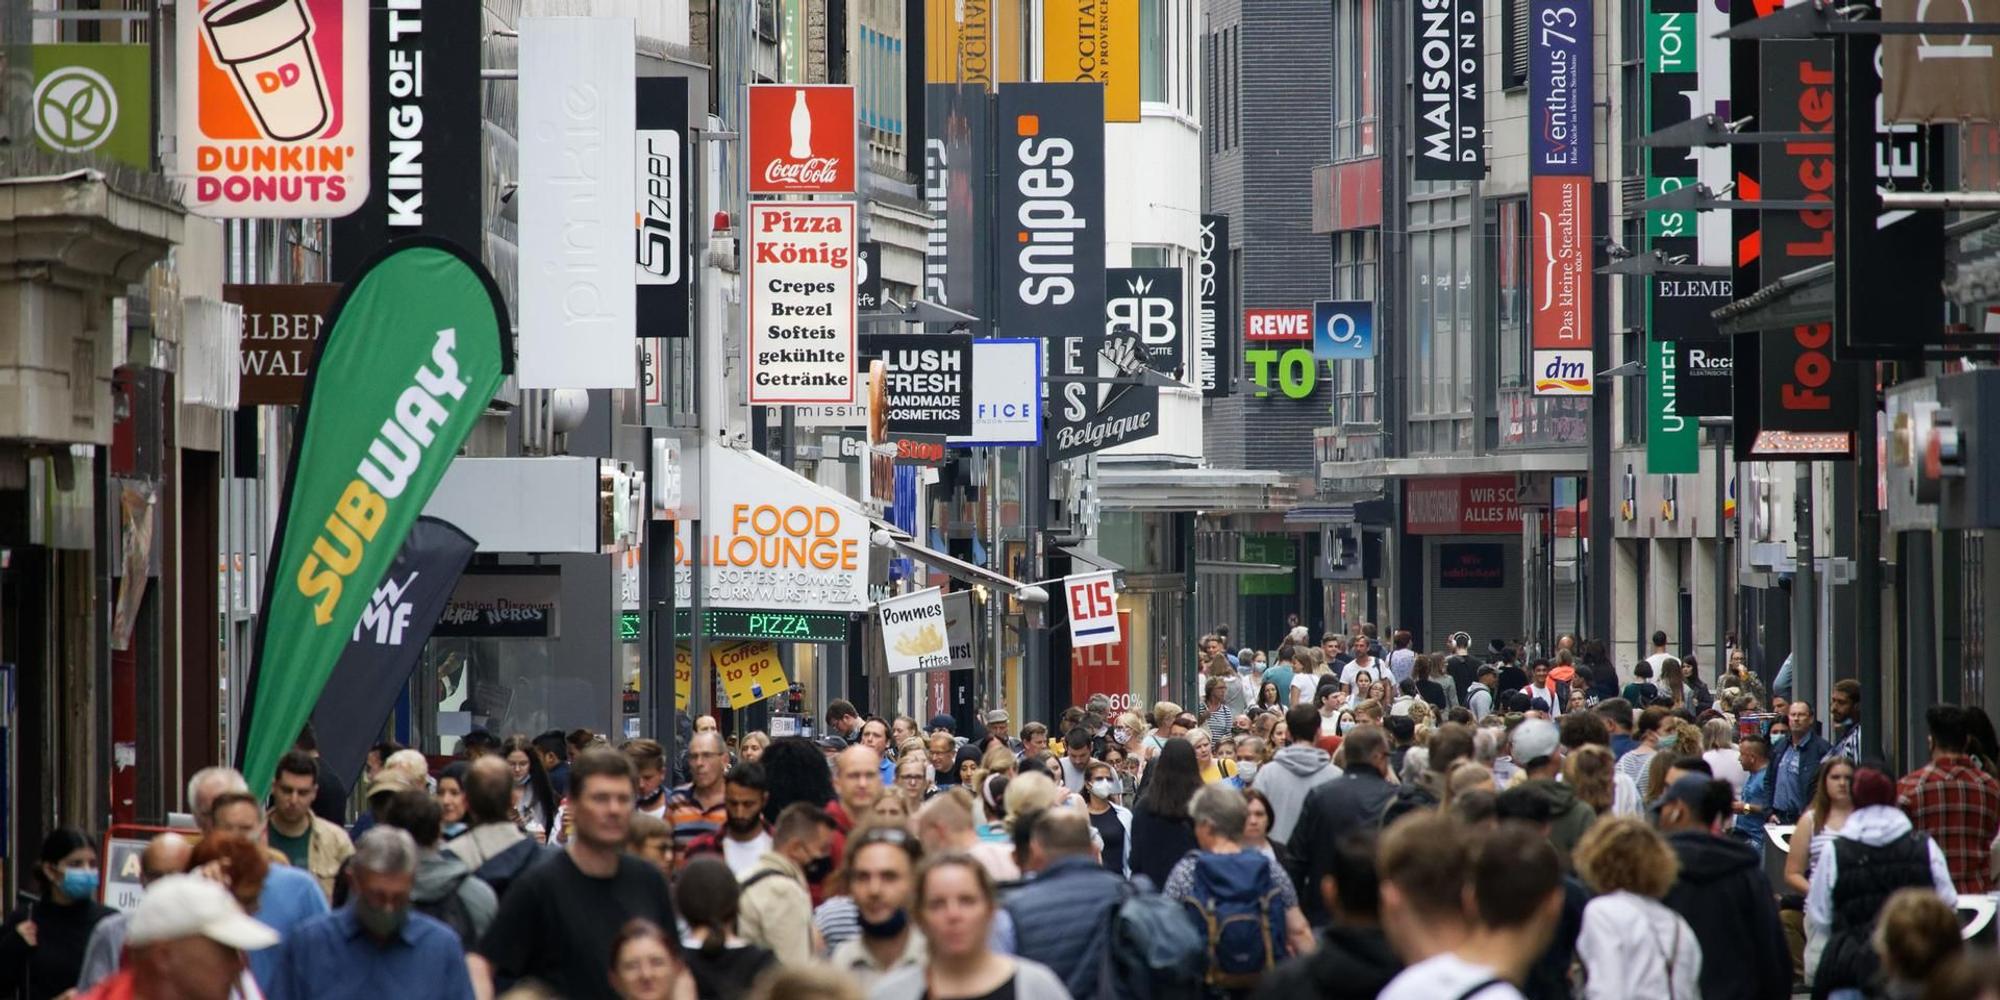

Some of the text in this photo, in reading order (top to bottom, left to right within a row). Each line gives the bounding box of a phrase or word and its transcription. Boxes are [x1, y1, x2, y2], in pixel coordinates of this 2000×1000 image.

[1075, 0, 1096, 82] CCITA
[1660, 13, 1682, 73] TON
[388, 50, 413, 98] OF
[1461, 10, 1477, 162] DU MOND
[1541, 6, 1577, 165] Eventhaus 73
[196, 146, 354, 172] DUNKIN'
[388, 105, 423, 226] KING
[196, 175, 347, 202] DONUTS
[761, 211, 843, 233] Pizza
[1018, 136, 1087, 306] snipes
[756, 242, 848, 268] König
[1559, 183, 1574, 340] Das kleine Steakhaus
[768, 279, 835, 296] Crepes
[771, 302, 832, 316] Brezel
[768, 326, 836, 340] Softeis
[1200, 309, 1216, 347] DAVID
[1250, 314, 1309, 335] REWE
[758, 349, 845, 366] gekühlte
[882, 350, 961, 372] LUSH
[1200, 349, 1216, 390] CAMP
[1545, 355, 1585, 379] dm
[756, 372, 848, 386] Getränke
[1056, 411, 1151, 451] Belgique
[1470, 488, 1496, 503] WIR
[732, 504, 841, 537] FOOD
[1464, 507, 1504, 522] ALLES
[713, 535, 859, 570] LOUNGE
[1070, 581, 1114, 621] EIS
[750, 616, 810, 635] PIZZA
[882, 603, 943, 626] Pommes
[720, 641, 770, 668] Coffee
[918, 654, 951, 669] Frites
[726, 658, 770, 682] to go
